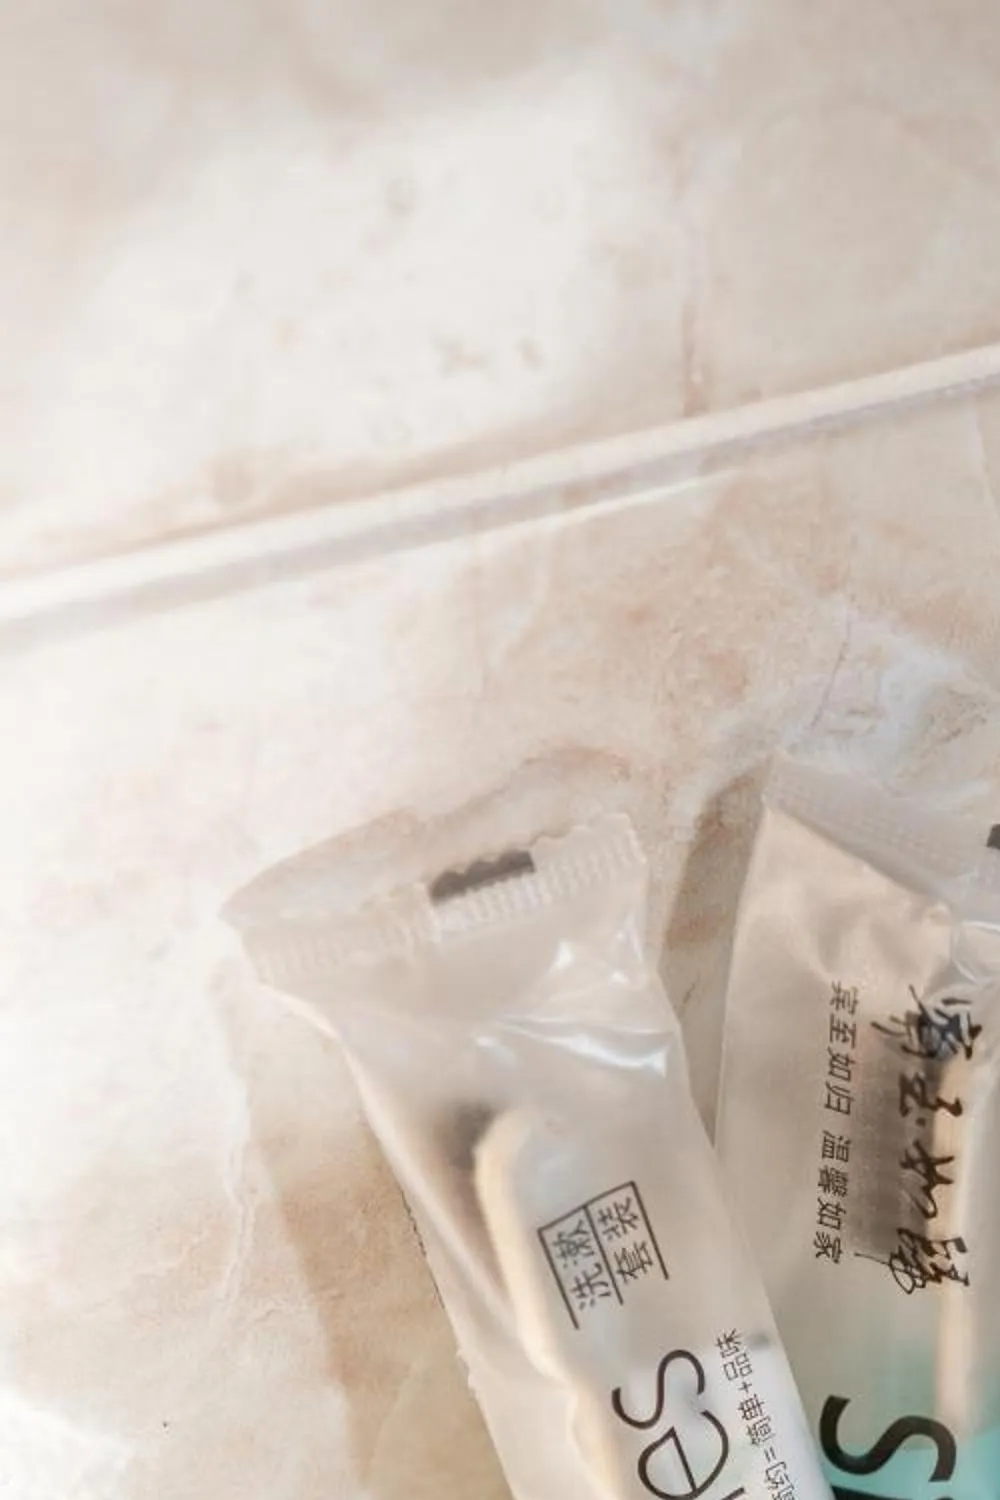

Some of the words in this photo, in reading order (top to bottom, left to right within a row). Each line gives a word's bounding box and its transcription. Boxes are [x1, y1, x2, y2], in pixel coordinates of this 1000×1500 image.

[824, 980, 858, 1116] 宾至如归
[597, 1196, 654, 1285] 套装
[813, 1130, 851, 1264] 温馨如家
[552, 1219, 612, 1311] 洗漱
